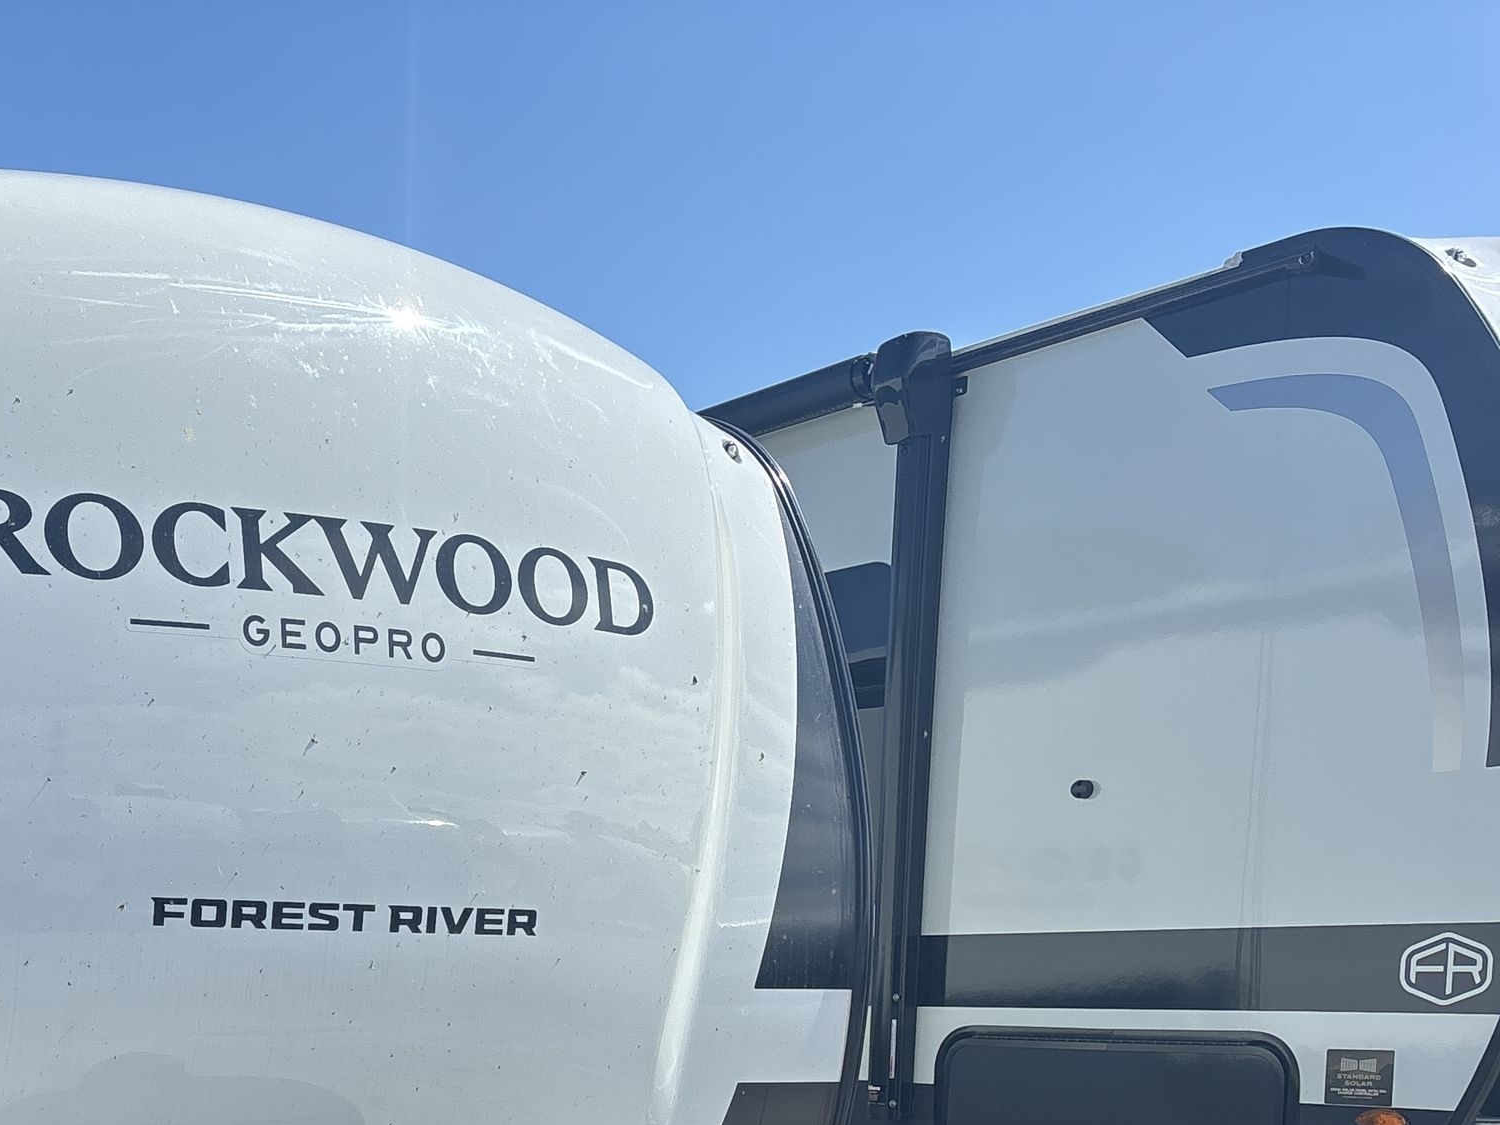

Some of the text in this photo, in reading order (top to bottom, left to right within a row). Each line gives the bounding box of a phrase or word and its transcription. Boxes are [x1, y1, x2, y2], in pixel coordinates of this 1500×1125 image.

[242, 614, 447, 663] GEOPRO
[150, 896, 538, 937] FOREST RIVER
[1336, 1073, 1382, 1081] STANDARD
